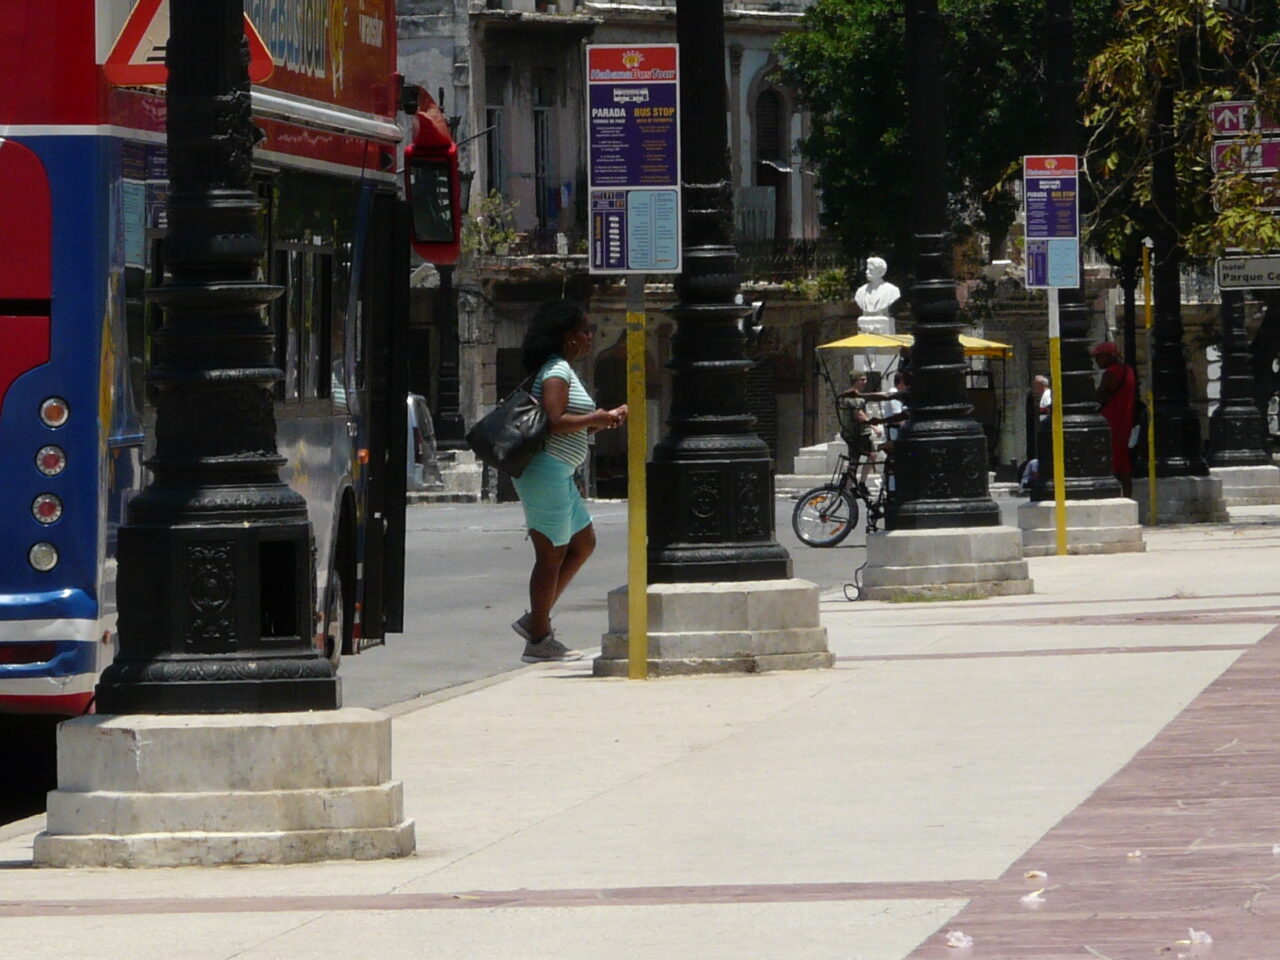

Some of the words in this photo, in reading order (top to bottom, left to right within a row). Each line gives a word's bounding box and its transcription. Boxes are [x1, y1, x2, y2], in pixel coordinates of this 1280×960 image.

[592, 107, 626, 117] PARADA
[634, 107, 651, 117] BUS
[653, 107, 675, 117] STOP
[1222, 263, 1246, 271] hotel
[1223, 272, 1264, 283] Parque
